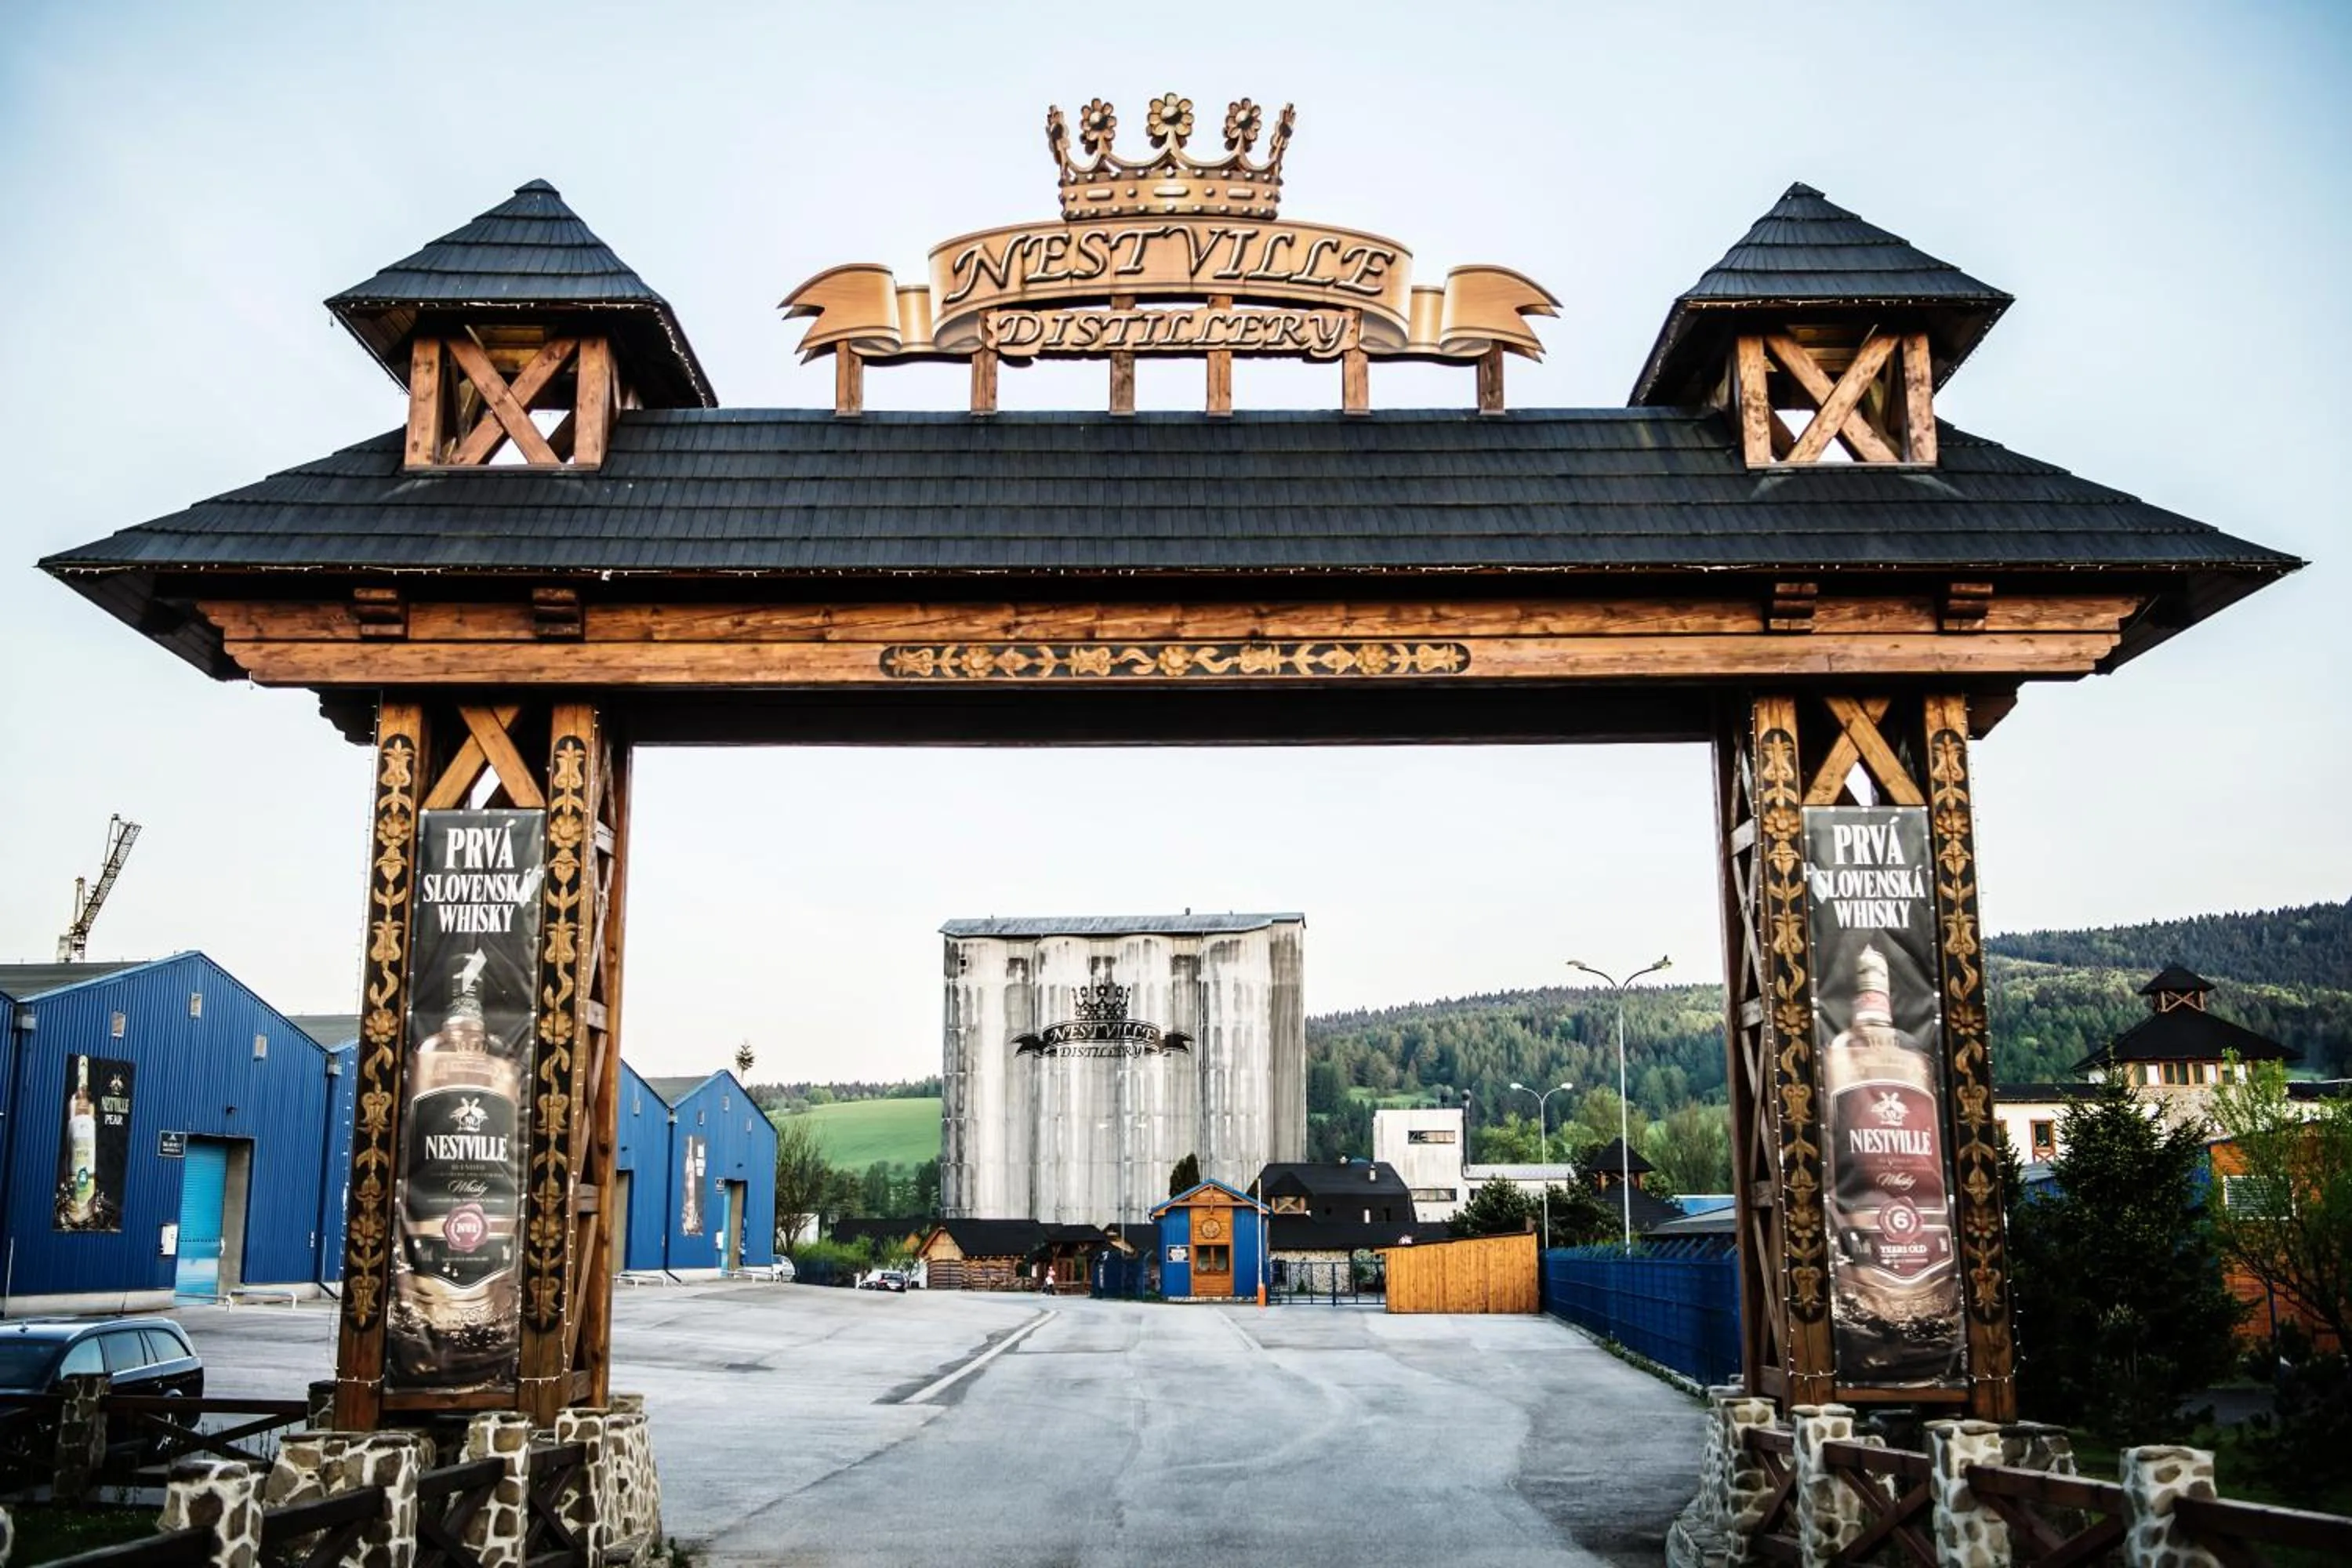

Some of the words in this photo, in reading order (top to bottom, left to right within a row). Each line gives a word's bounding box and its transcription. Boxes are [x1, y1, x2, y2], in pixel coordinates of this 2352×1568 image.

[944, 225, 1396, 303] NESTVILLE
[997, 312, 1348, 353] DISTILLERY
[445, 818, 517, 869] PRVÁ
[1832, 816, 1905, 865] PRVÁ
[423, 868, 532, 902] SLOVENSKÁ
[1817, 866, 1926, 898] SLOVENSKÁ
[438, 904, 515, 933] WHISKY
[1834, 900, 1911, 928] WHISKY
[1050, 1023, 1156, 1044] NESTVILLE
[104, 1114, 123, 1125] PEAR
[426, 1134, 508, 1161] NESTVILLE
[1849, 1128, 1932, 1156] NESTVILLE
[1893, 1212, 1909, 1229] 6
